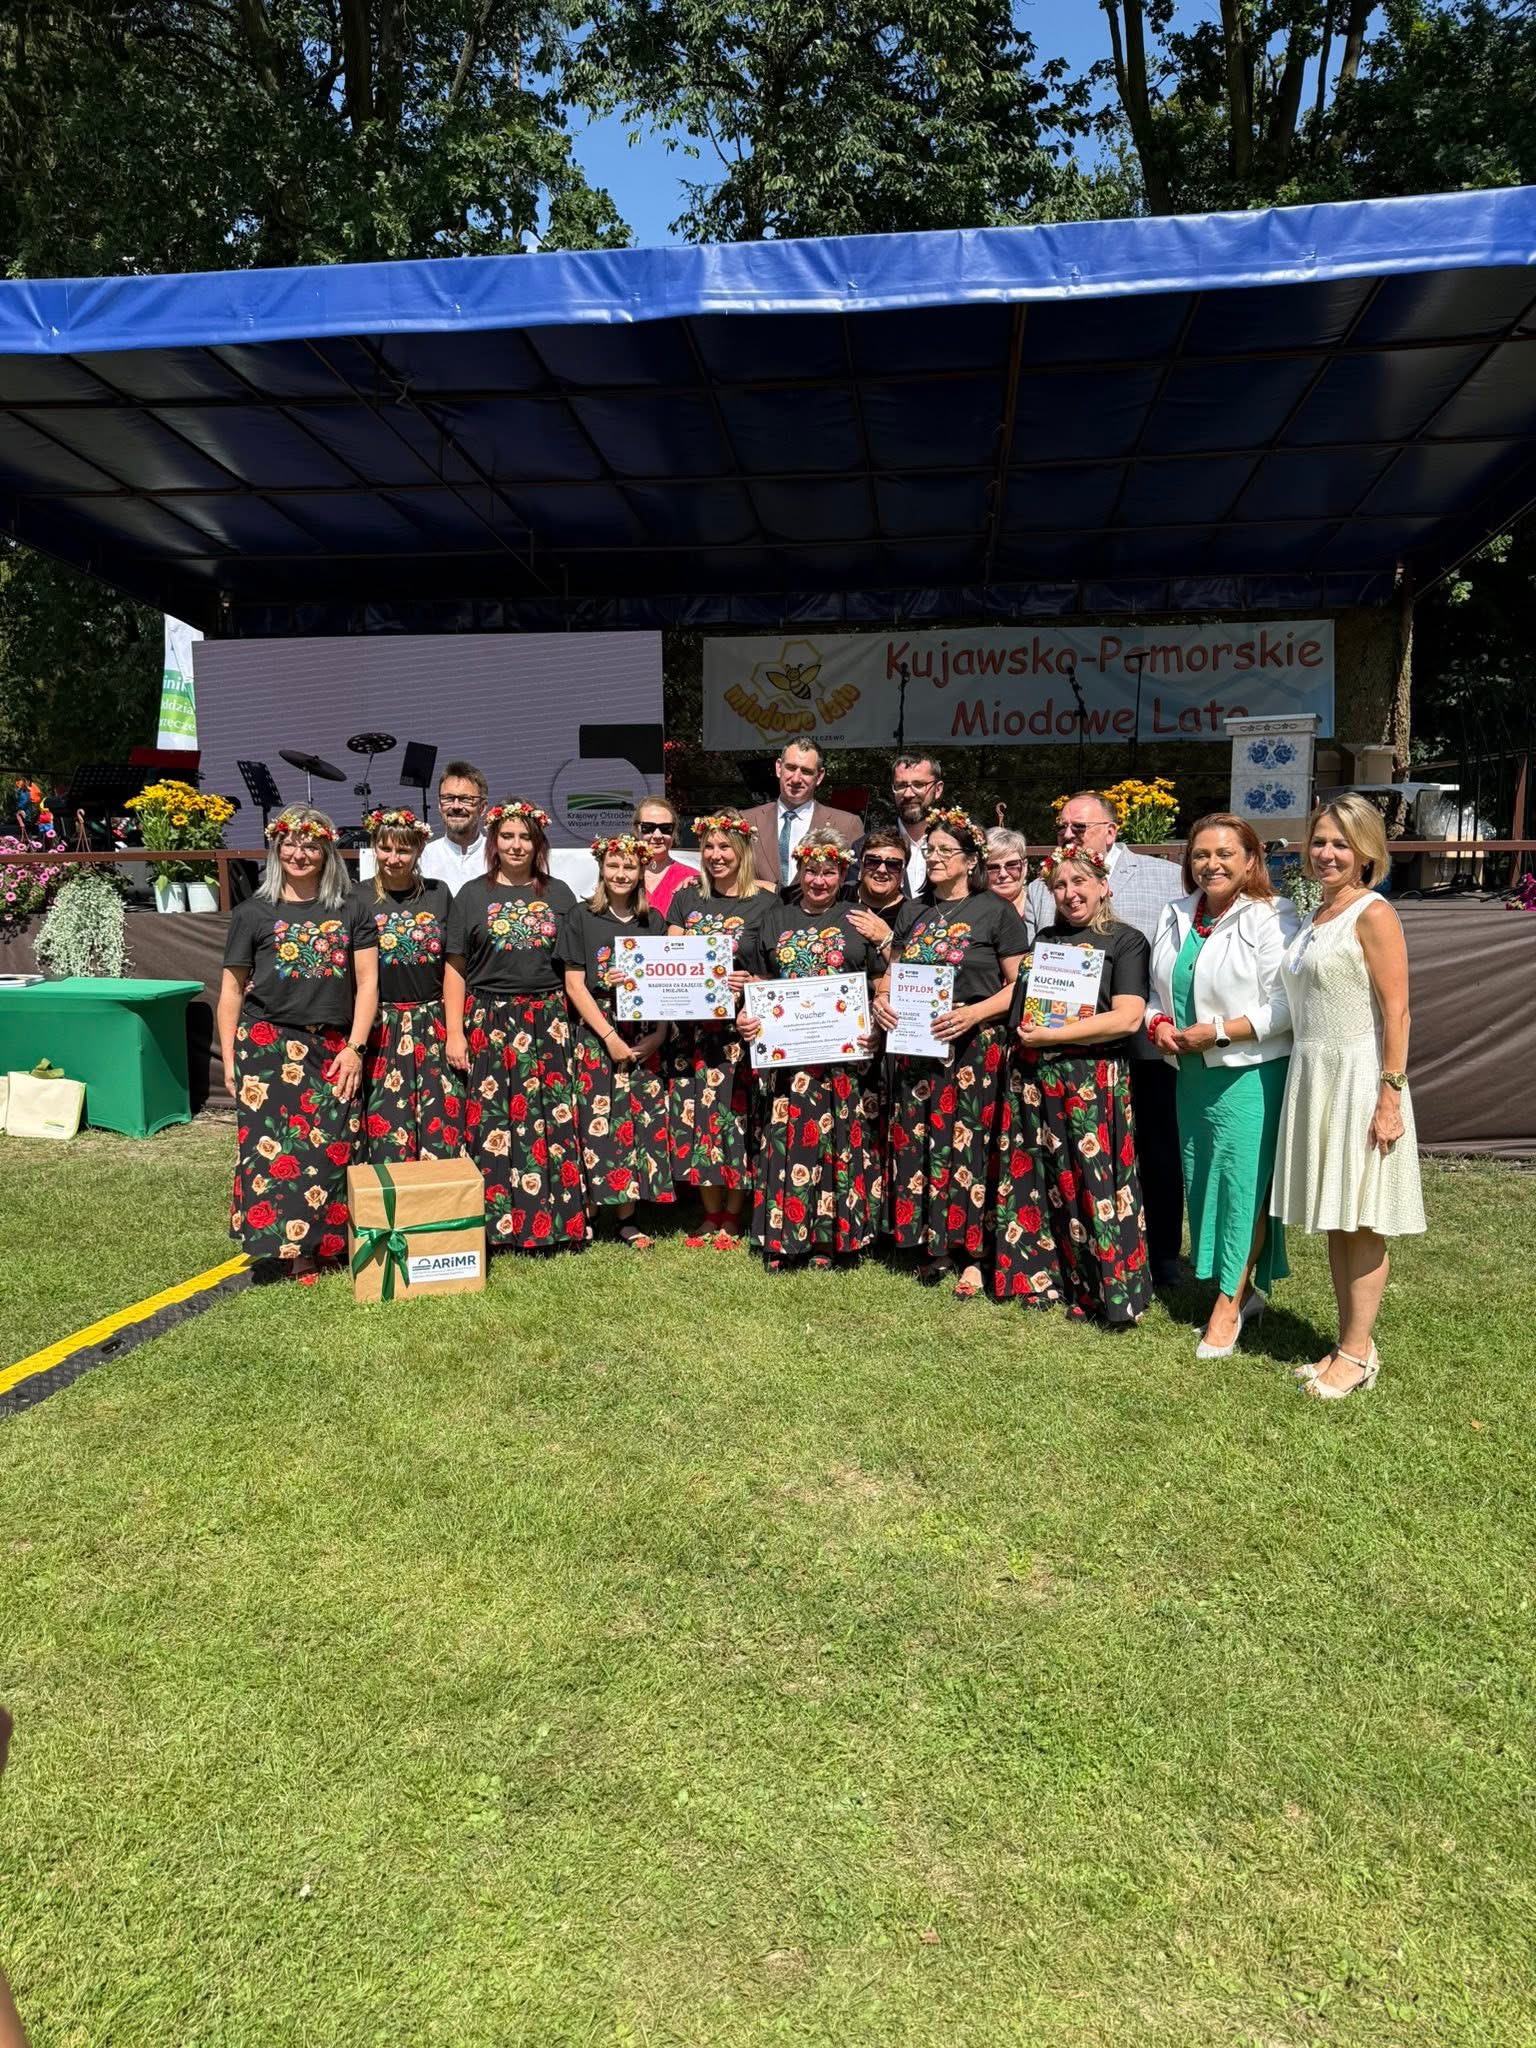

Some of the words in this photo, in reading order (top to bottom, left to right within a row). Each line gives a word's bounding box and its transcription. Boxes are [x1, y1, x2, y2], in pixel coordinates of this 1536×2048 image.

[886, 629, 1324, 689] Kujawsko-Pomorskie
[723, 683, 817, 733] miodowe
[951, 698, 1136, 736] Miodowe
[567, 812, 597, 821] Krajowy
[645, 963, 687, 976] 5000
[690, 963, 704, 976] zł
[1033, 975, 1076, 988] KUCHNIA
[897, 984, 934, 994] DYPLOM
[794, 1011, 826, 1020] Voucher
[431, 1255, 477, 1270] ARiMR
